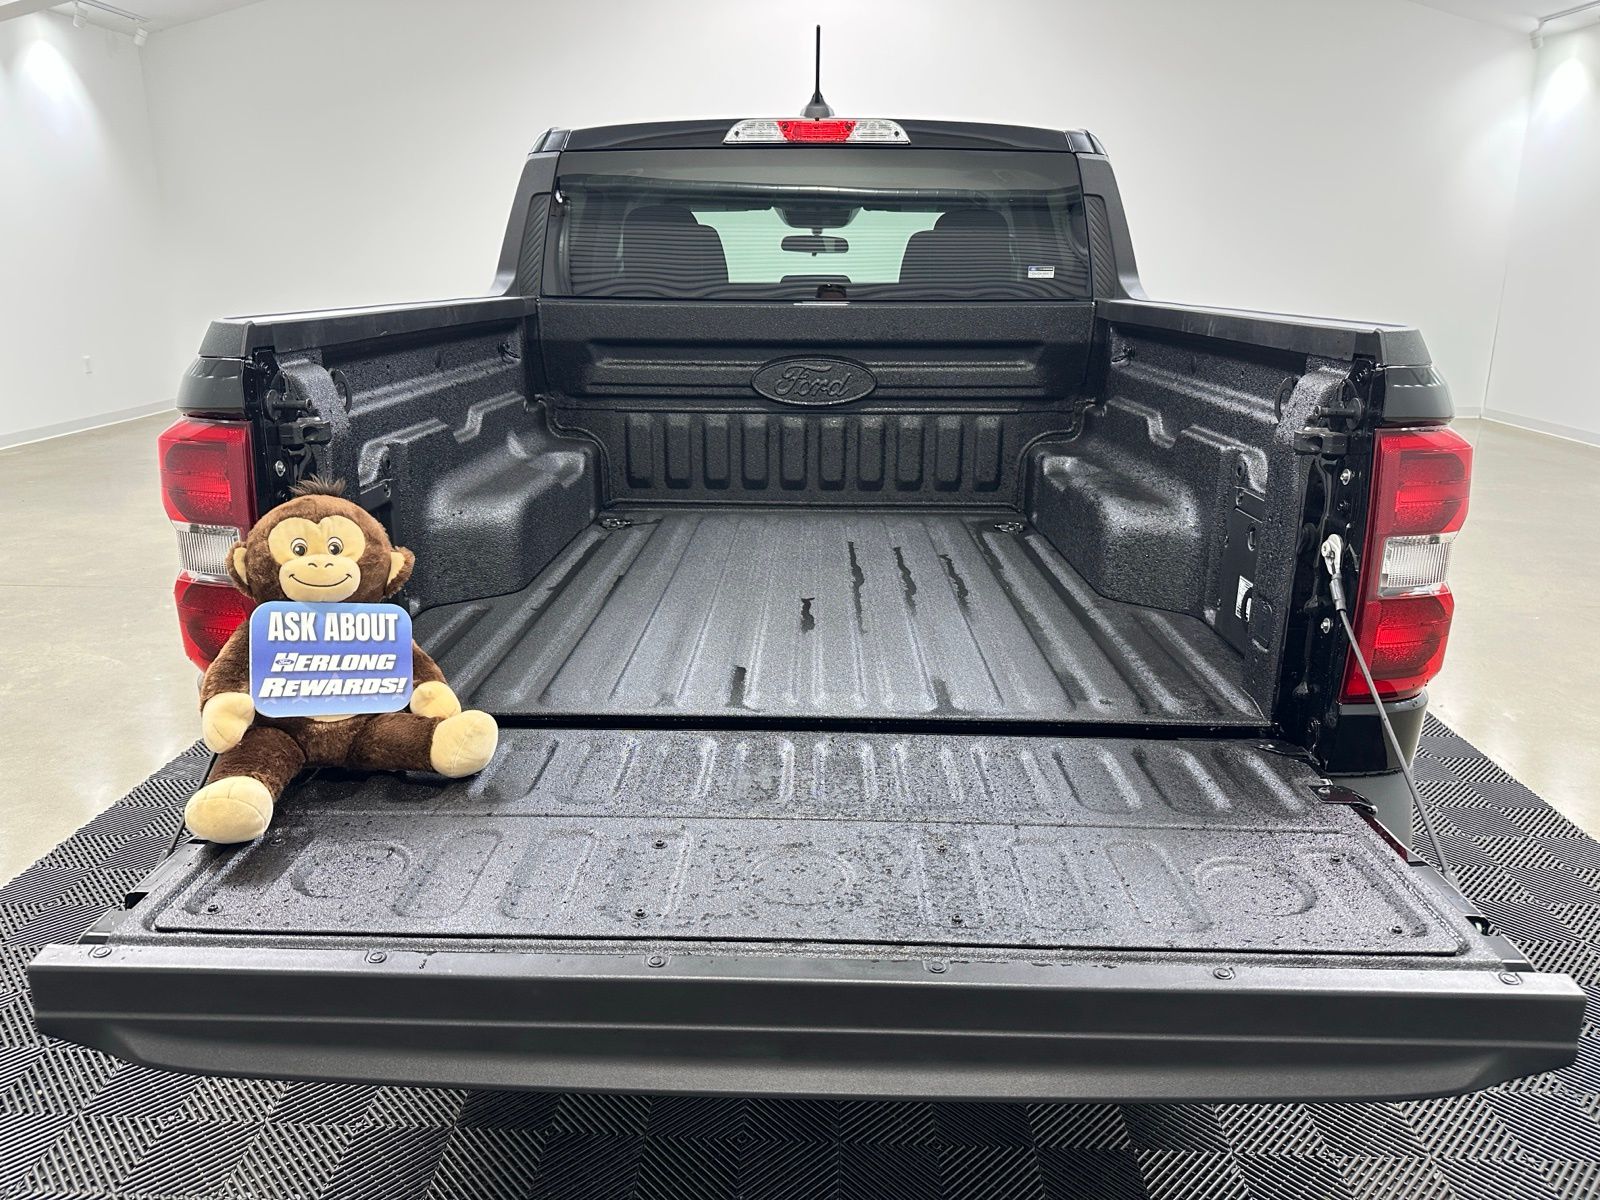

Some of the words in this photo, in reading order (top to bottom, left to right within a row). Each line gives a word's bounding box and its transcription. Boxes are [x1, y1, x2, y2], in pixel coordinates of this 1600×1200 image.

[774, 364, 852, 397] Ford
[268, 611, 317, 642] ASK
[324, 612, 399, 642] ABOUT
[270, 652, 397, 673] HERLONG
[258, 677, 408, 698] REWARDS!
